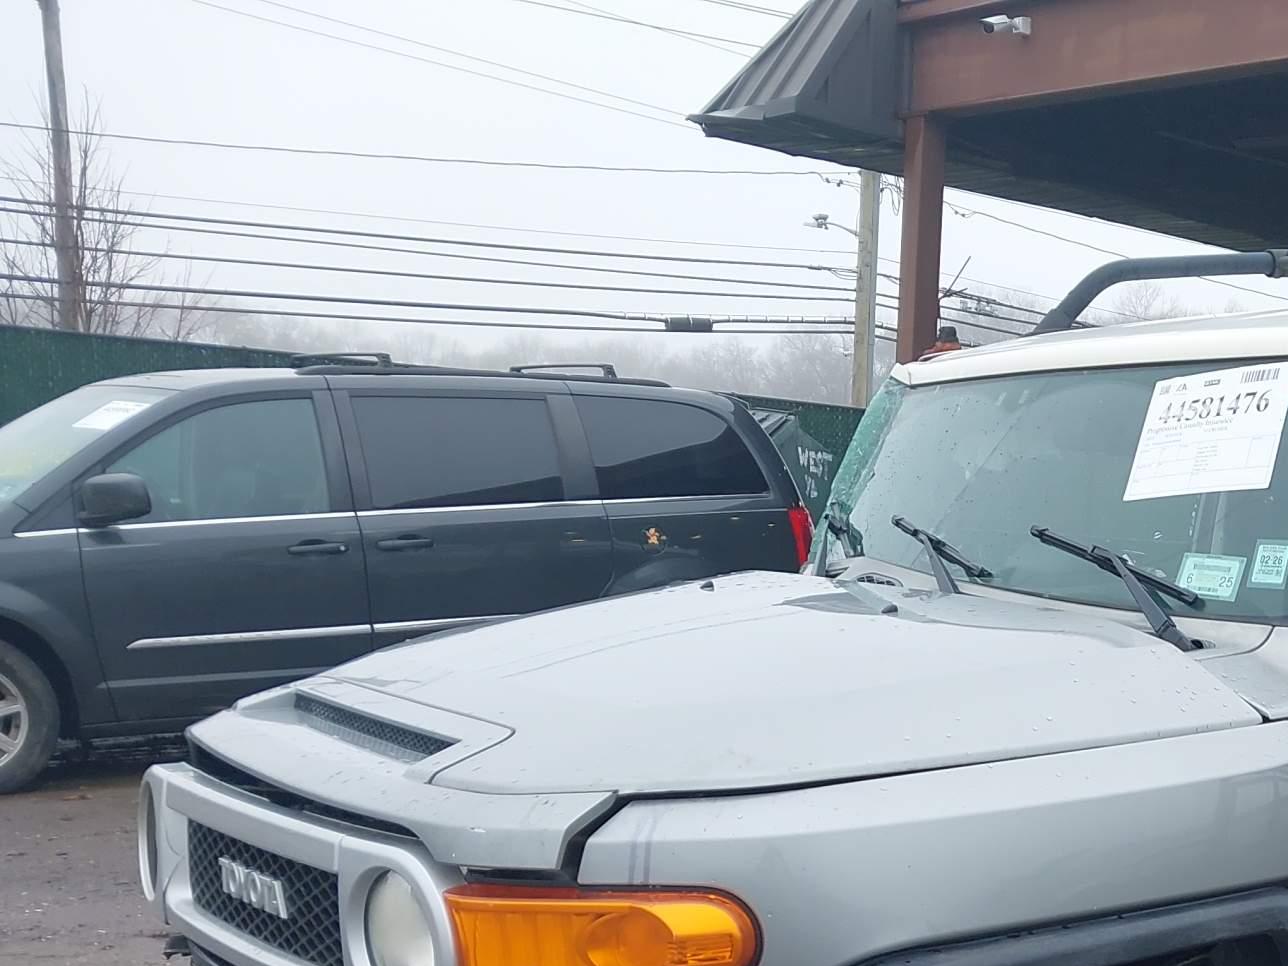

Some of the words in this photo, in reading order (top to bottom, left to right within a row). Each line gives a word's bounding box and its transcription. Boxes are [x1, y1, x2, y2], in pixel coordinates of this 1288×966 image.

[1158, 389, 1272, 423] 44581476
[797, 446, 833, 481] WEST
[1186, 572, 1194, 584] 6
[1218, 576, 1234, 588] 25
[218, 855, 288, 919] TOYOTA
